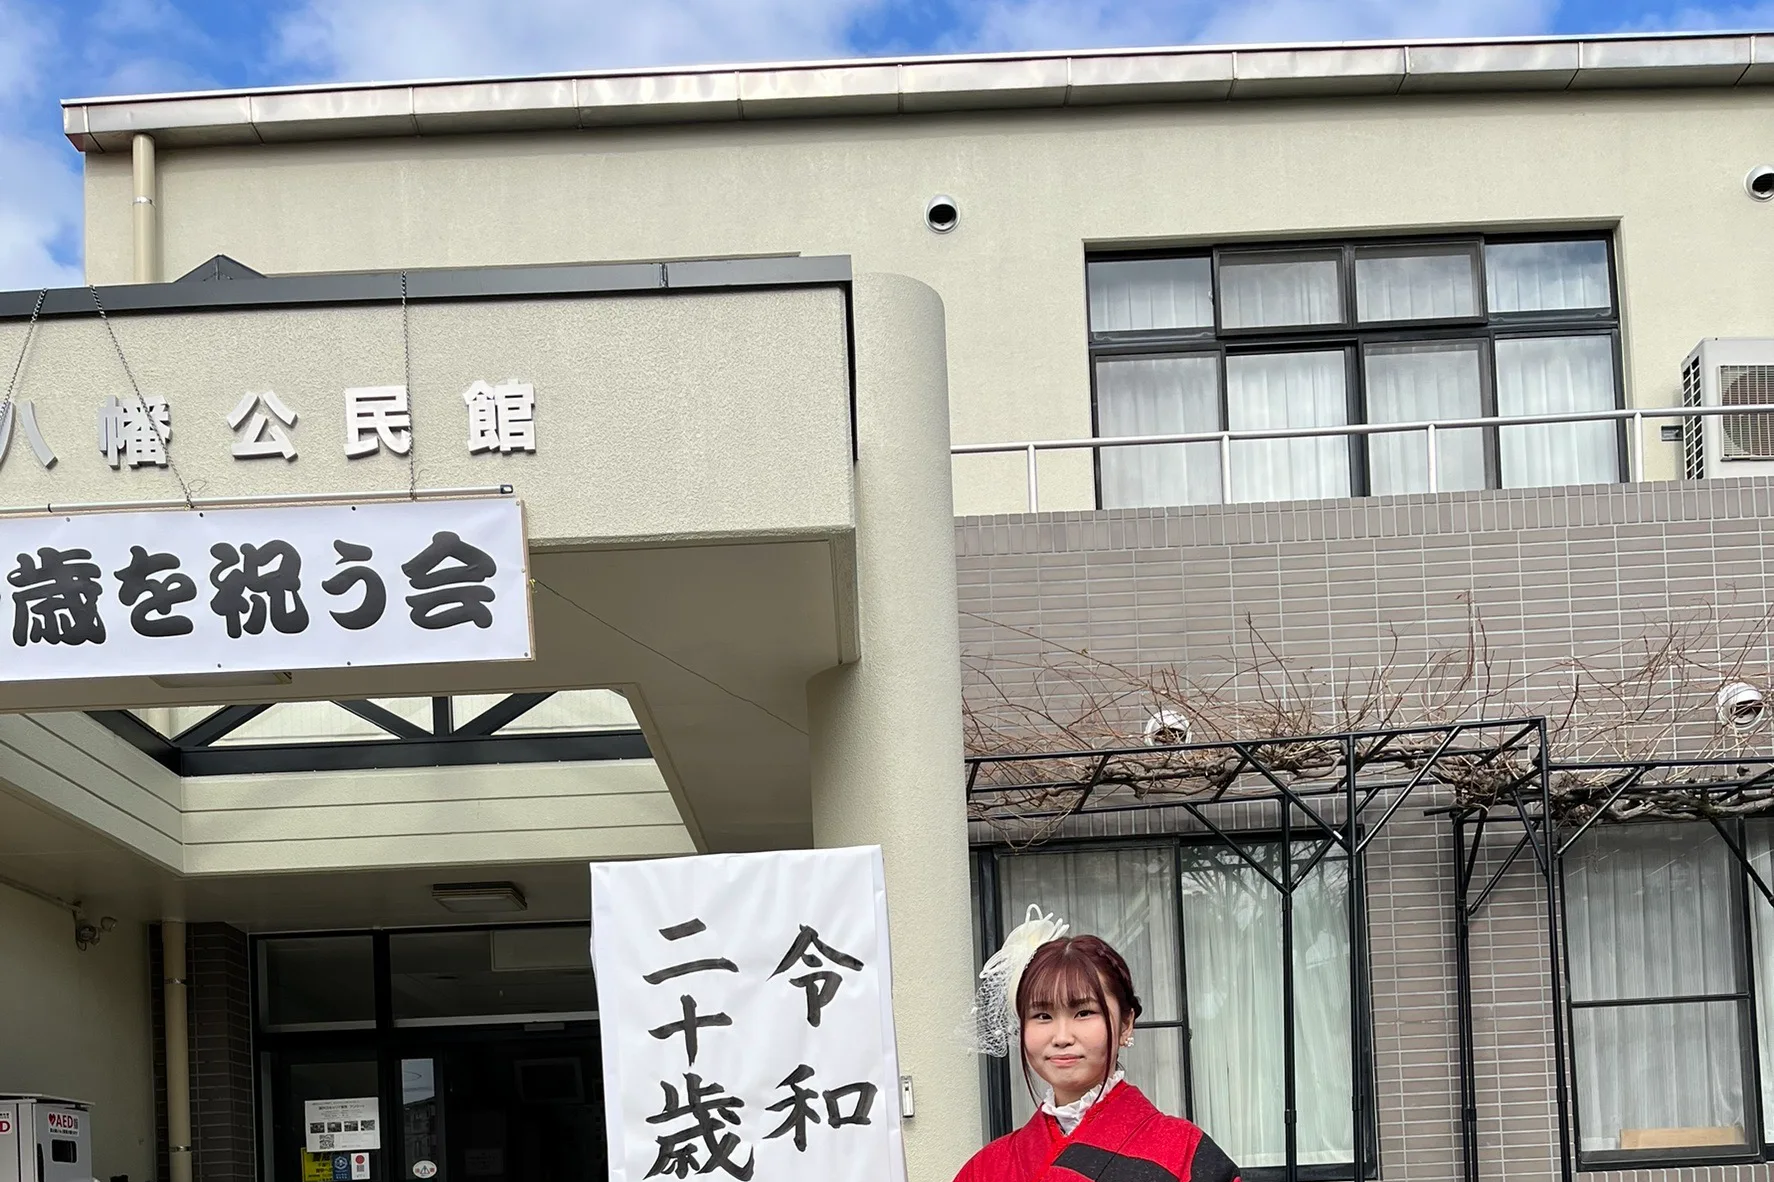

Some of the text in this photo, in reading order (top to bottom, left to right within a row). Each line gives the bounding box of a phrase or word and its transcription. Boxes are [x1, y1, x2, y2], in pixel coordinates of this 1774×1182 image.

[7, 531, 497, 647] 歳を祝う会
[56, 1114, 73, 1129] AED
